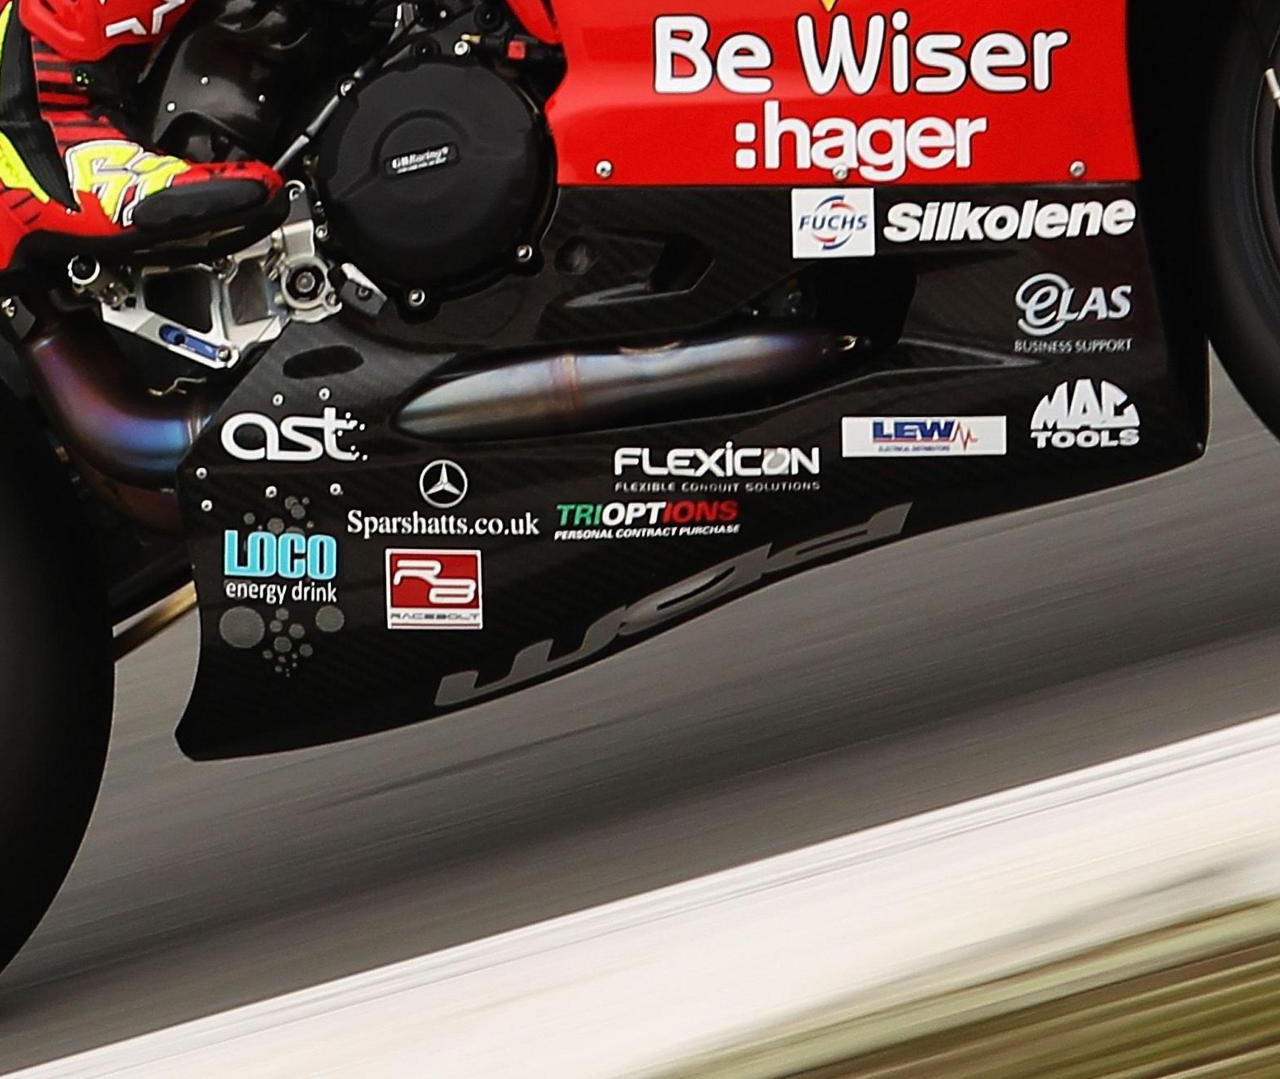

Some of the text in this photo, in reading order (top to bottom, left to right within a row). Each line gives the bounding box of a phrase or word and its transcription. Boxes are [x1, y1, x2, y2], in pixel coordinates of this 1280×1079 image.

[653, 8, 1070, 96] Be Wiser
[733, 99, 989, 182] :hager
[798, 198, 1137, 244] FUCHS Silkolene
[1014, 338, 1133, 354] BUSINESS SUPPORT
[1030, 378, 1141, 430] MAC
[872, 420, 956, 440] LEW
[1030, 428, 1141, 450] TOOLS
[614, 480, 821, 493] FLEXIBLE CONDUIT SOLUTIONS
[346, 509, 541, 540] Sparshatts.co.uk
[556, 499, 740, 527] TRIOPTIONS
[554, 523, 741, 541] PERSONAL CONTRACT PURCHASE
[224, 529, 338, 581] LOCO
[225, 580, 338, 606] energy drink
